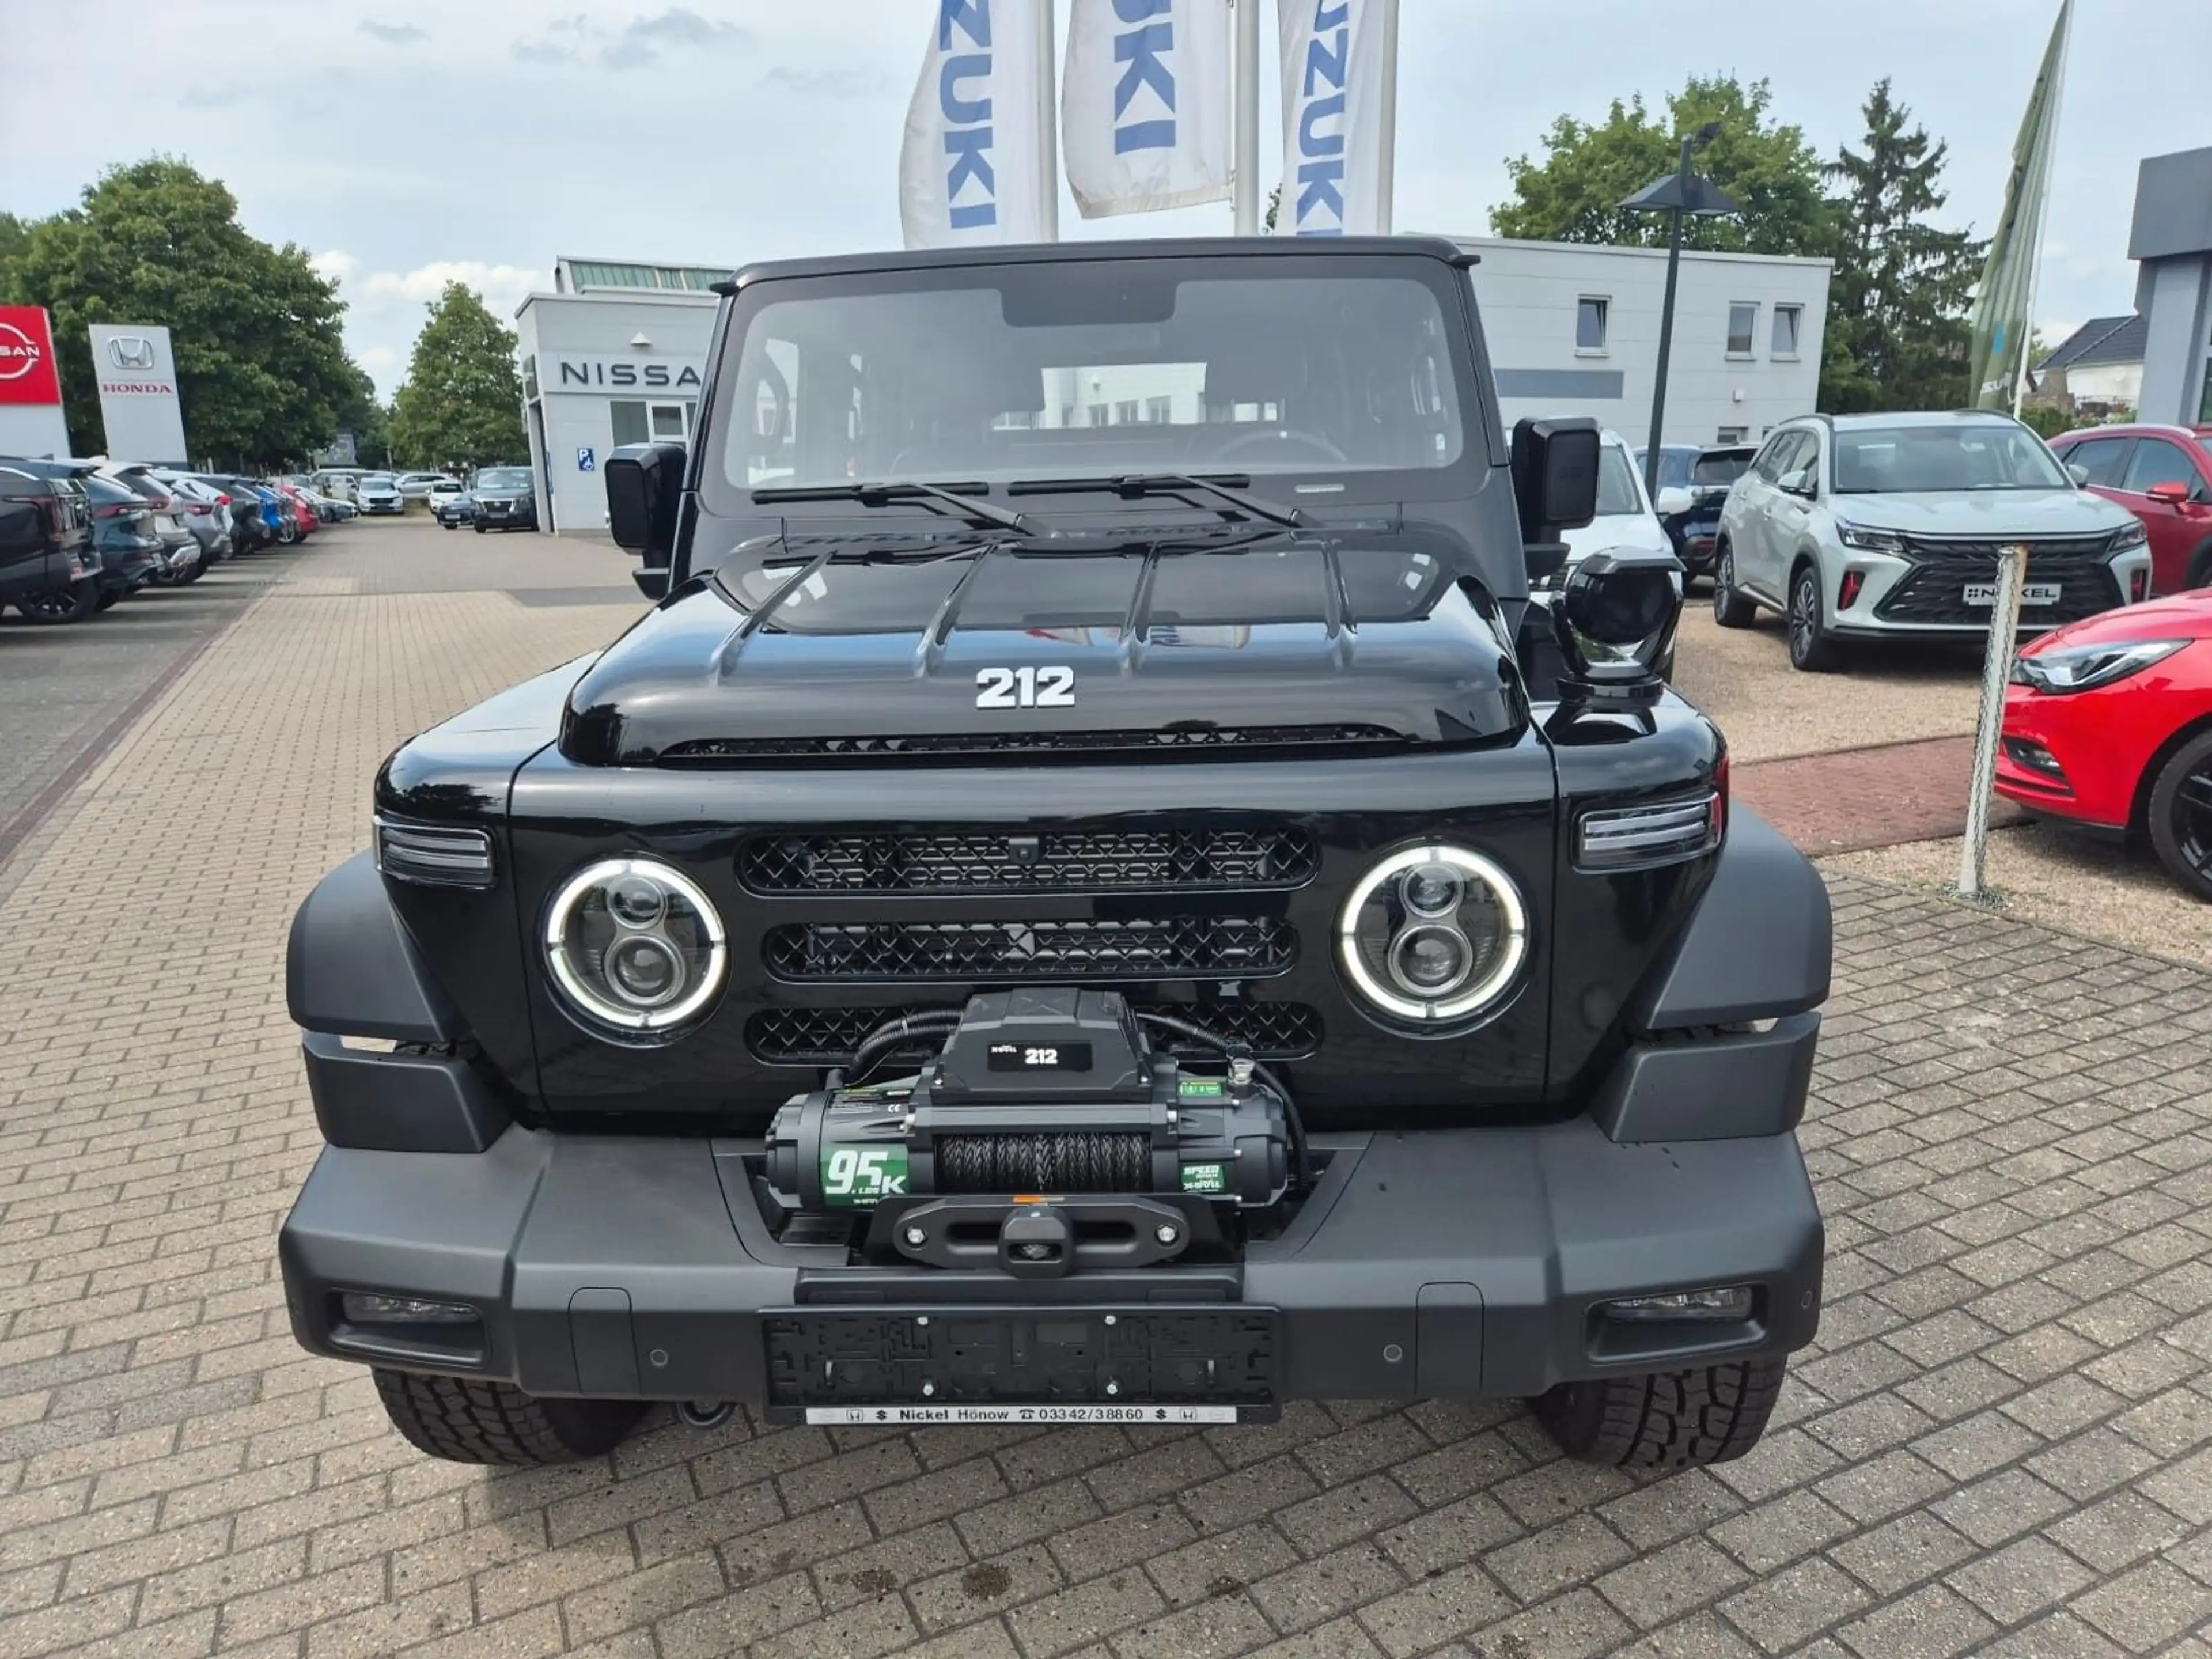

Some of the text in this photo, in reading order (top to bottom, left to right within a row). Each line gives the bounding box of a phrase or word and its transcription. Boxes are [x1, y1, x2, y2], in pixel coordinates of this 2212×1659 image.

[103, 384, 171, 393] HONDA
[976, 665, 1075, 708] 212
[1025, 1048, 1058, 1064] 212
[899, 1409, 948, 1420] Nickel
[957, 1409, 1009, 1420] Hönow
